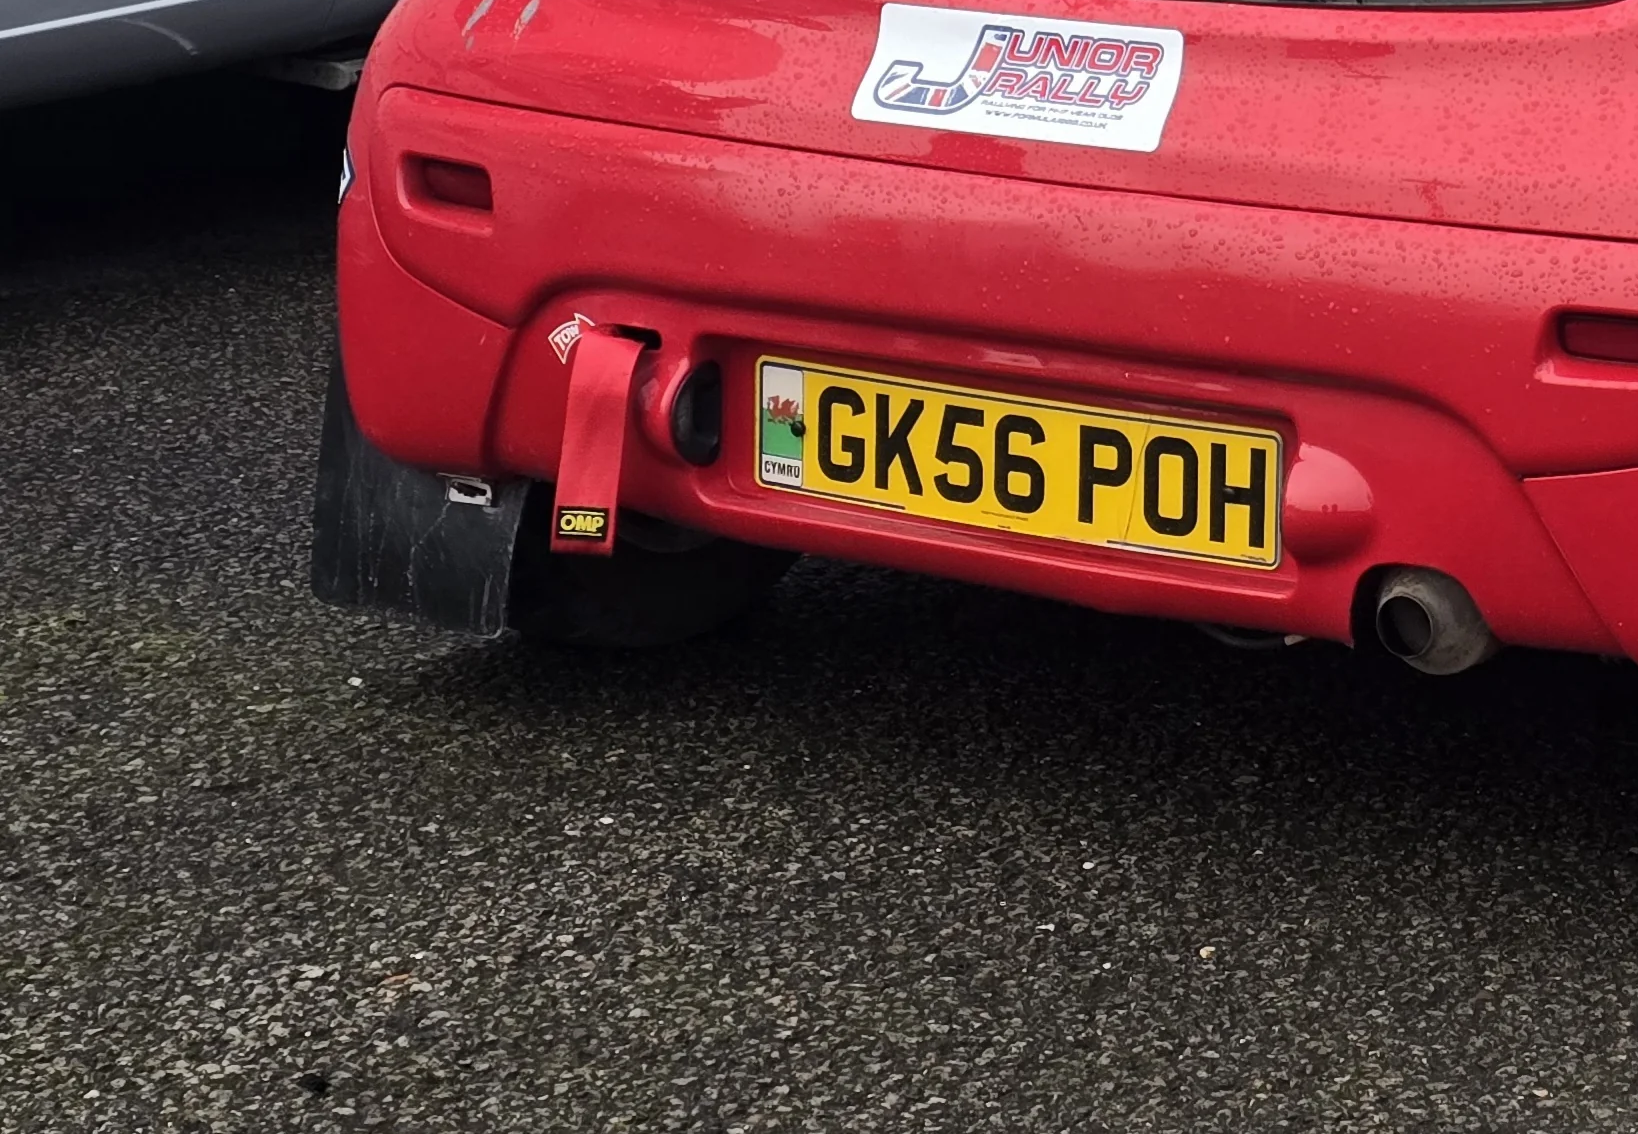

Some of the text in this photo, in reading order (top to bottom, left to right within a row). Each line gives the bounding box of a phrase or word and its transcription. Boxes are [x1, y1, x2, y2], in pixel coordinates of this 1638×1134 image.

[984, 66, 1149, 110] RALLY
[554, 324, 579, 351] TOW
[764, 460, 800, 478] CYMRU
[818, 385, 1267, 550] GK56 POH
[560, 514, 604, 532] OMP
